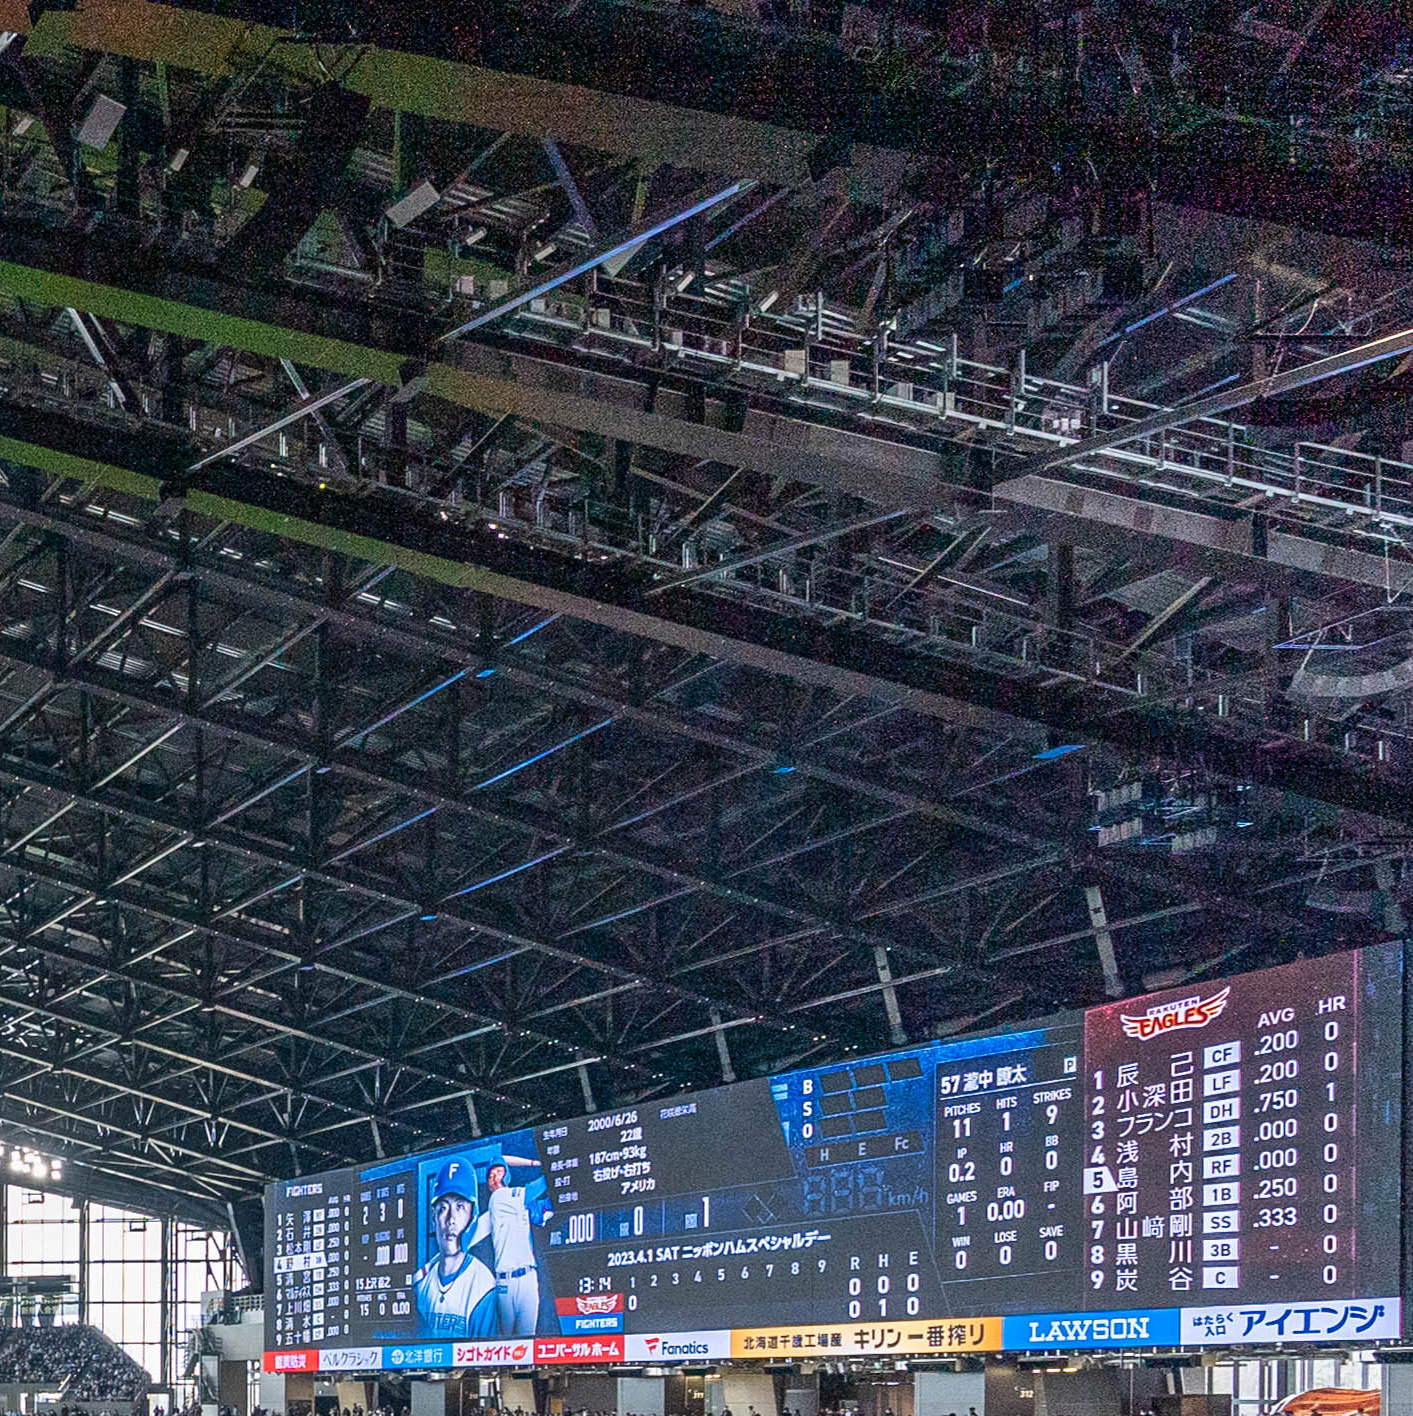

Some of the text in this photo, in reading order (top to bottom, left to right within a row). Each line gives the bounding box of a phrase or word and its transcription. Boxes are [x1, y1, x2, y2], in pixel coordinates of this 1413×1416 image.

[1149, 997, 1198, 1016] RAKUTEN
[1318, 995, 1346, 1012] HR
[1138, 1007, 1210, 1037] EAGLES
[1257, 1008, 1295, 1028] AVG
[1254, 1029, 1298, 1056] .200
[1116, 1052, 1194, 1089] 辰己
[1254, 1059, 1298, 1084] .200
[941, 1074, 961, 1095] 57
[996, 1096, 1018, 1109] HITS
[1034, 1088, 1072, 1103] STRIKES
[1117, 1079, 1193, 1113] 小深田
[1254, 1089, 1298, 1113] .750
[944, 1102, 981, 1117] PITCHES
[953, 1117, 971, 1139] 11
[1117, 1108, 1193, 1138] フランコ
[1254, 1119, 1297, 1142] .000
[1000, 1141, 1013, 1153] HR
[1045, 1135, 1059, 1147] BB
[1116, 1134, 1194, 1164] 浅村
[957, 1147, 967, 1159] IP
[1254, 1148, 1297, 1171] .000
[948, 1161, 975, 1183] 0.2
[1117, 1160, 1193, 1190] 島内
[997, 1186, 1016, 1199] ERA
[1044, 1180, 1059, 1192] FIP
[1253, 1177, 1298, 1200] .250
[946, 1191, 977, 1205] GAMES
[1116, 1187, 1194, 1216] 阿部
[986, 1199, 1025, 1222] 0.00
[1253, 1207, 1298, 1229] .333
[952, 1235, 971, 1248] WIN
[994, 1230, 1017, 1243] LOSE
[1039, 1225, 1064, 1238] SAVE
[607, 1230, 831, 1268] 2023.4.1 SAT ニッポンハムスペシャルデー
[1116, 1240, 1193, 1266] 黒川
[1116, 1267, 1193, 1292] 炭谷
[575, 1316, 618, 1330] FIGHTERS
[1193, 1311, 1234, 1327] はたらく
[1240, 1303, 1386, 1338] アイエンジ
[1029, 1317, 1149, 1343] LAWSON
[1204, 1322, 1227, 1338] 入口
[662, 1339, 709, 1357] Fanatics
[743, 1332, 842, 1351] 北海道千歳工場産
[323, 1350, 377, 1367] ベルクラシック
[404, 1348, 443, 1364] 北洋銀行
[456, 1345, 511, 1362] シゴトガイド
